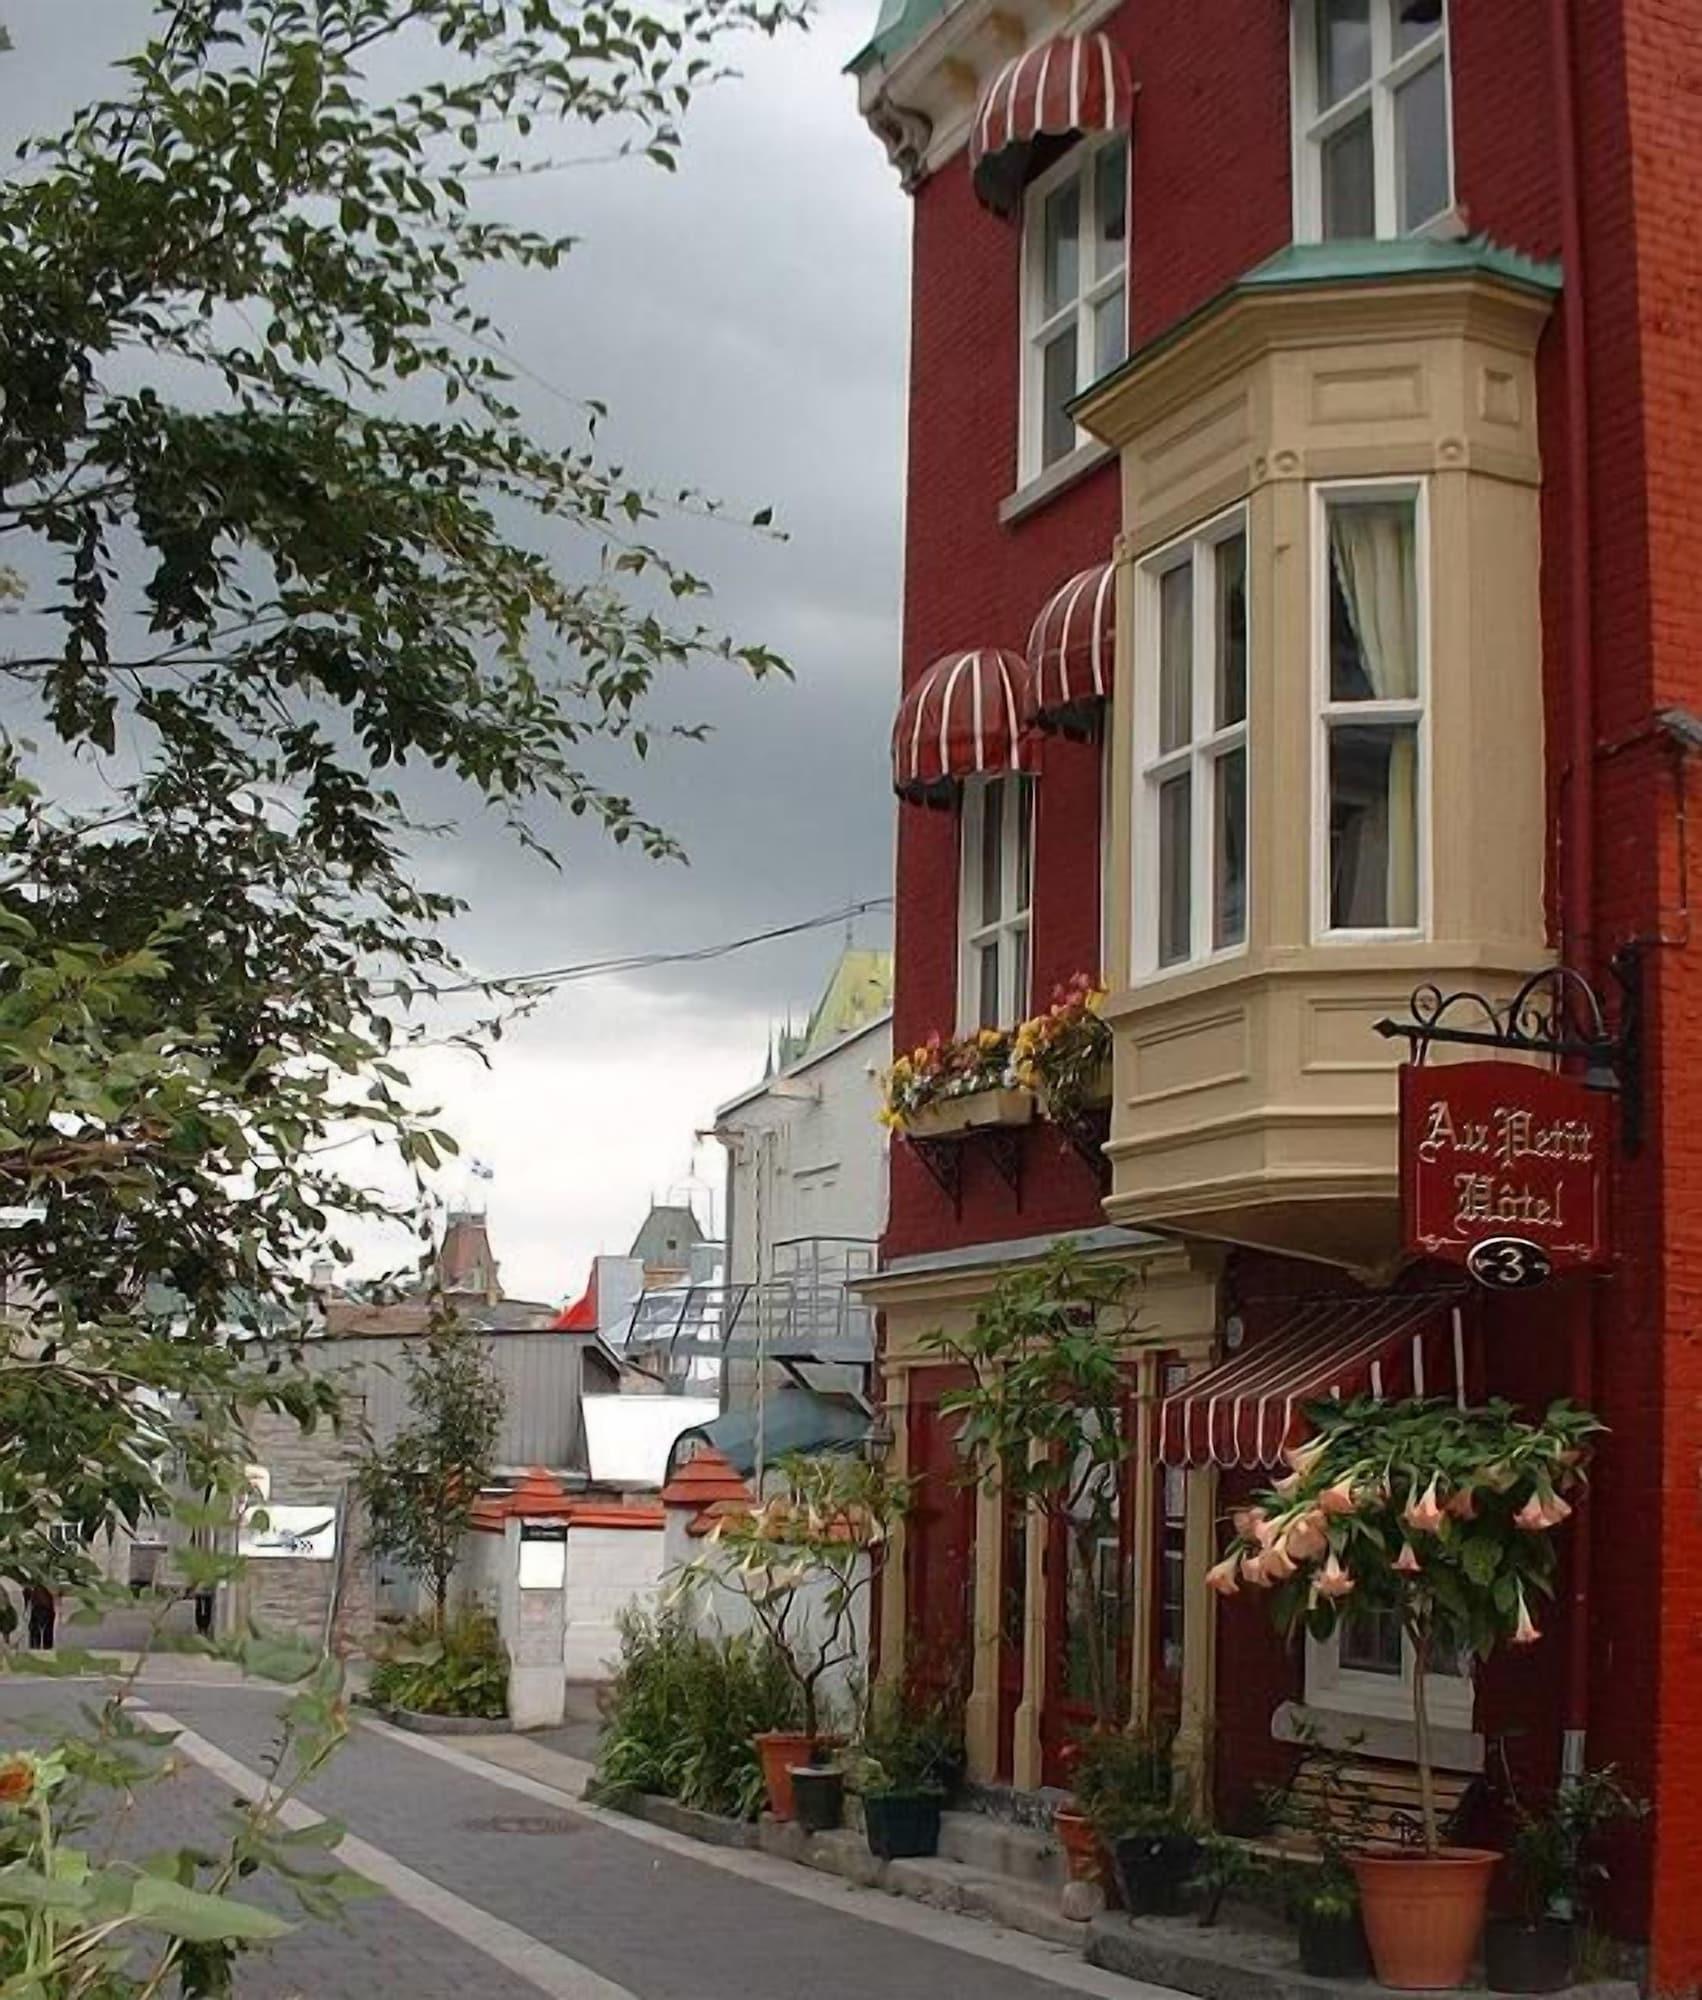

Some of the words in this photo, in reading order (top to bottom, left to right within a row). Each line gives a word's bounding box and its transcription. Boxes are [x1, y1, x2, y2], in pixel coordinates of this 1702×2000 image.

[1419, 1101, 1488, 1162] Au
[1493, 1107, 1593, 1166] Petit
[1454, 1173, 1563, 1234] Hôtel
[1497, 1247, 1525, 1282] 3
